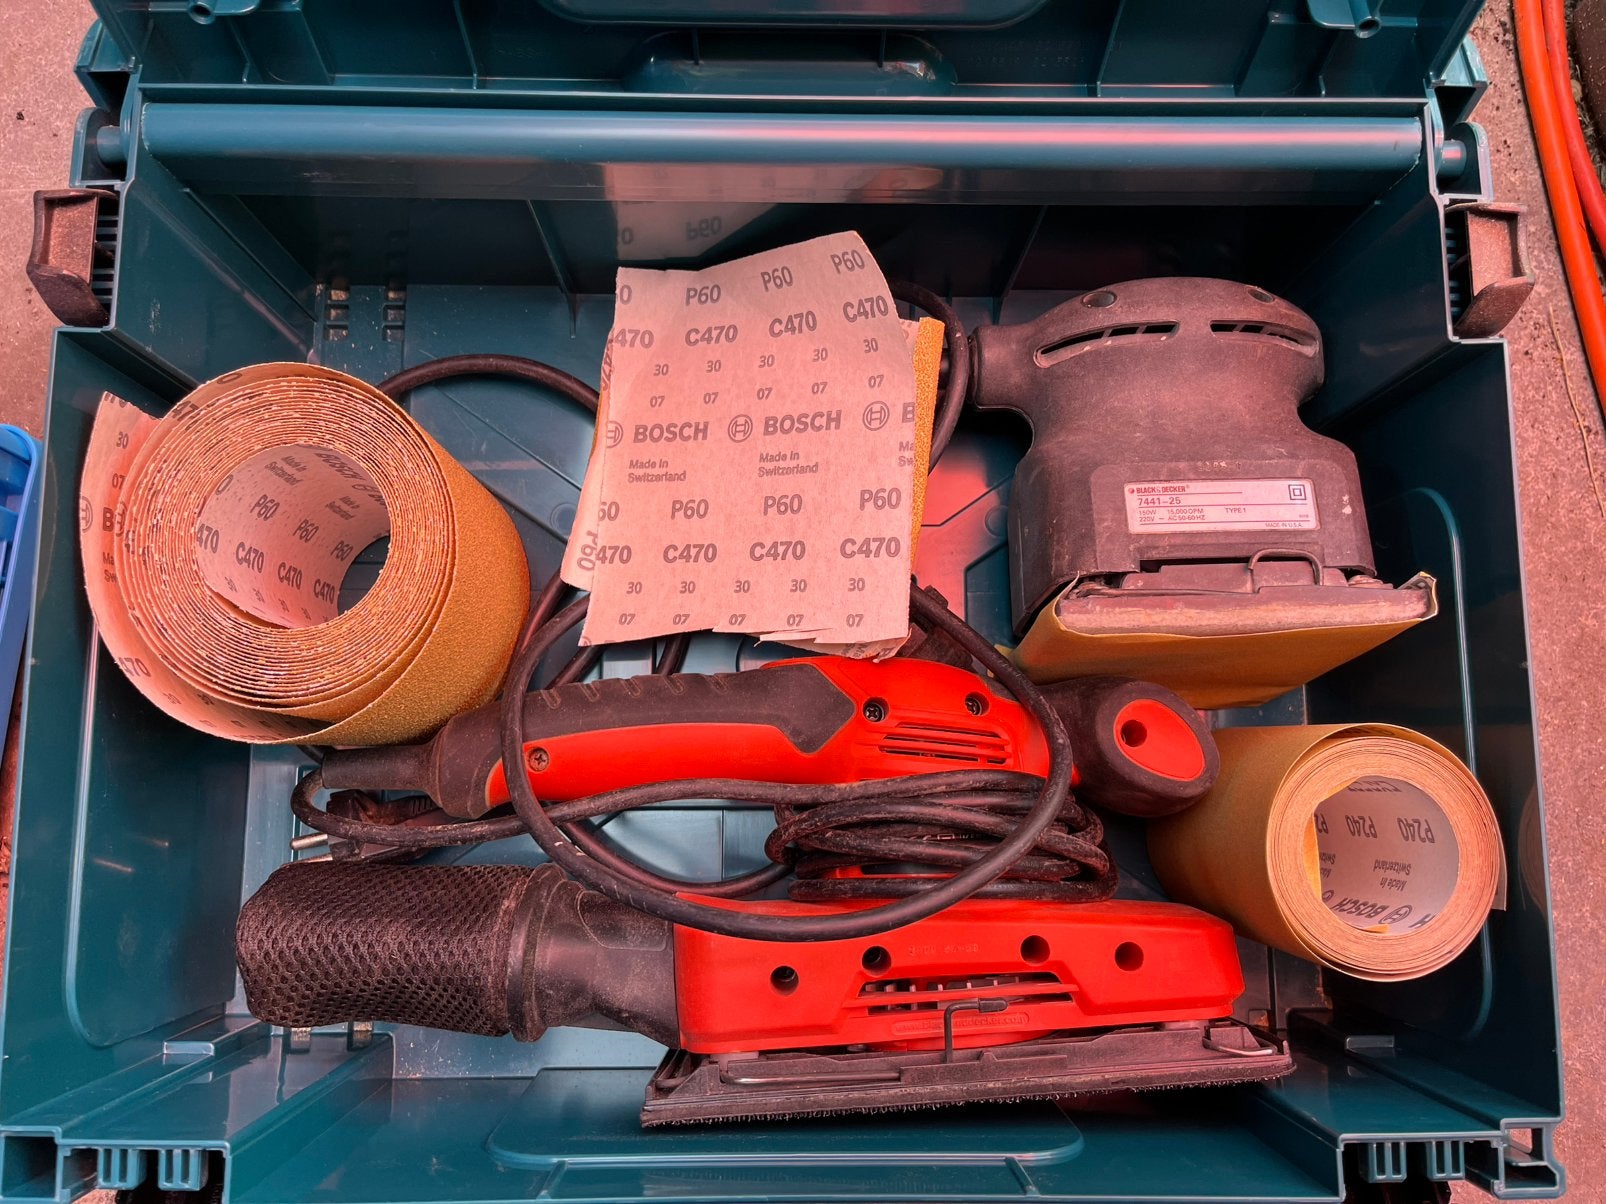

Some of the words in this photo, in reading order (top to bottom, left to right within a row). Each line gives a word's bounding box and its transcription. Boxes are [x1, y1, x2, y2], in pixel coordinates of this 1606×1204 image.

[831, 249, 865, 274] P60
[760, 266, 793, 292] P60
[685, 284, 721, 306] P60
[613, 329, 654, 348] 470
[684, 324, 738, 346] C470
[768, 310, 818, 338] C470
[842, 295, 888, 324] C470
[653, 363, 669, 376] 30
[706, 360, 721, 373] 30
[759, 354, 775, 368] 30
[813, 348, 828, 362] 30
[863, 338, 878, 353] 30
[649, 395, 665, 408] 07
[703, 392, 718, 405] 07
[757, 387, 773, 400] 07
[811, 382, 828, 395] 07
[868, 375, 884, 388] 07
[633, 422, 709, 443] BOSCH
[763, 410, 842, 435] BOSCH
[116, 431, 129, 448] 30
[629, 459, 656, 469] Made
[759, 451, 787, 463] Made
[628, 470, 686, 482] Switzerland
[758, 462, 818, 477] Switzerland
[1136, 486, 1156, 494] BLACK
[1161, 485, 1186, 493] DECKER
[599, 501, 620, 522] 60
[671, 499, 709, 520] P60
[763, 494, 803, 516] P60
[859, 488, 902, 511] P60
[1137, 496, 1181, 506] 7441-25
[250, 494, 280, 521] P60
[293, 519, 319, 543] P60
[331, 541, 353, 561] P60
[596, 544, 632, 564] 470
[663, 543, 718, 564] C470
[749, 540, 806, 561] C470
[840, 536, 901, 559] C470
[197, 524, 219, 553] 470
[236, 542, 264, 573] C470
[278, 562, 302, 589] C470
[314, 579, 335, 604] C470
[626, 581, 642, 594] 30
[679, 580, 696, 594] 30
[733, 579, 750, 593] 30
[790, 579, 807, 593] 30
[848, 577, 866, 592] 30
[619, 613, 636, 625] 07
[672, 613, 690, 625] 07
[729, 613, 746, 626] 07
[787, 613, 804, 626] 07
[846, 613, 864, 627] 07
[118, 657, 151, 677] 470
[1345, 815, 1378, 838] P240
[1397, 817, 1435, 843] P240
[1373, 859, 1411, 876] Switzerland
[1330, 897, 1389, 918] BOSCH
